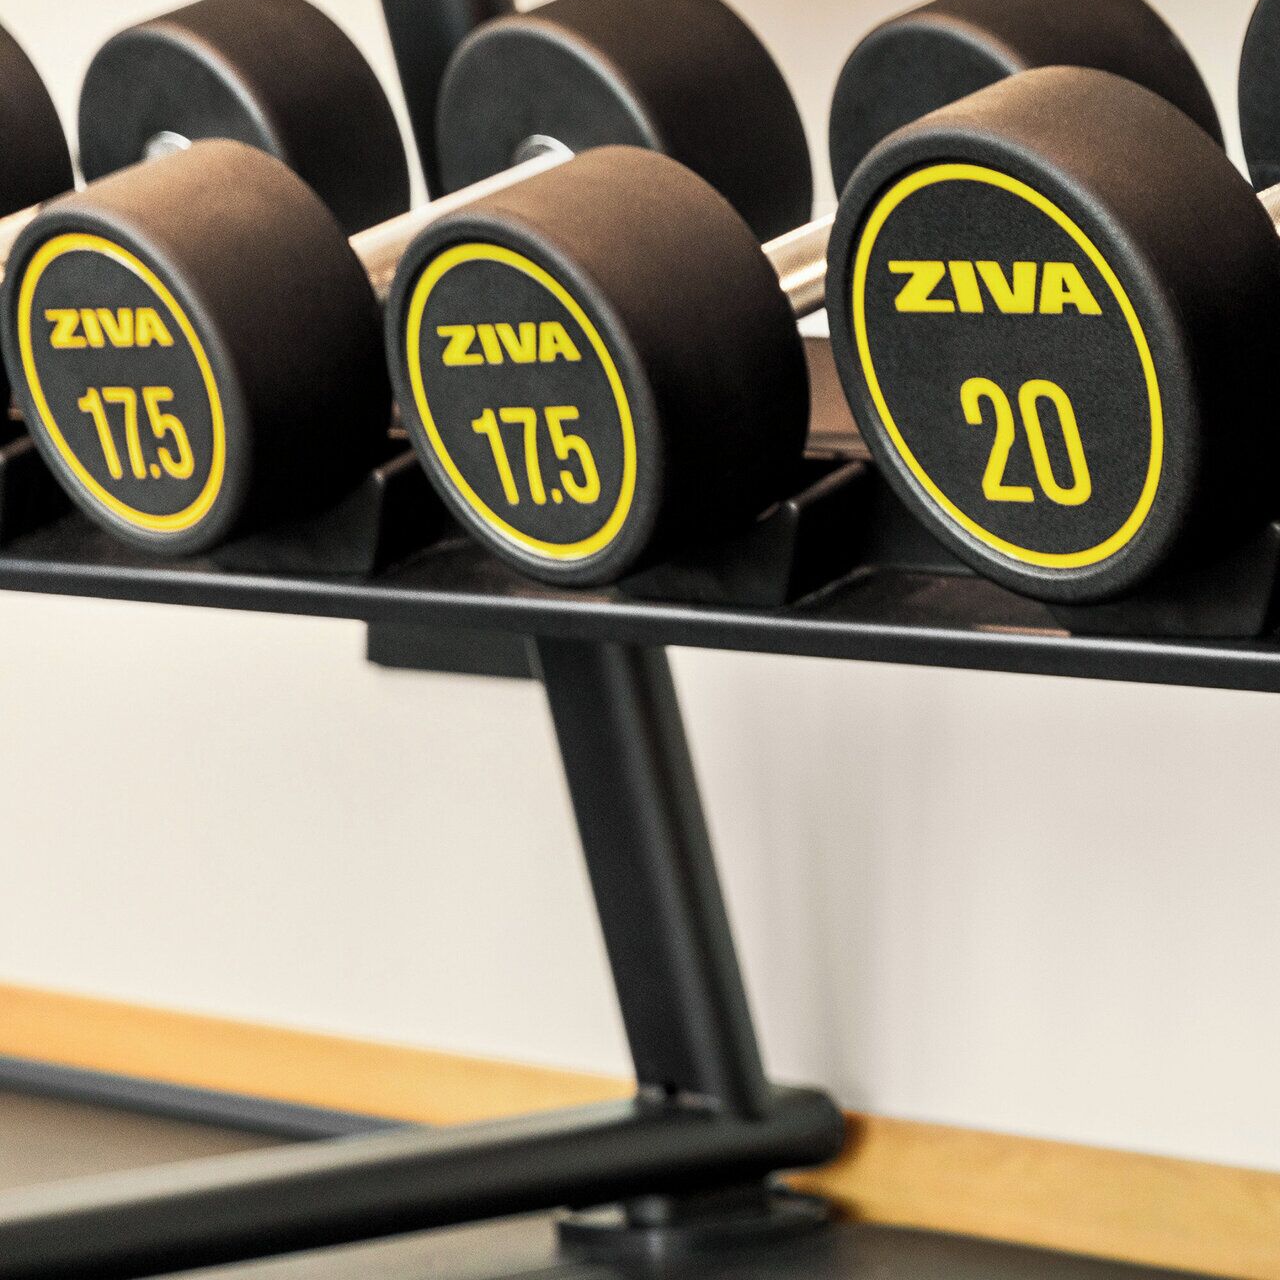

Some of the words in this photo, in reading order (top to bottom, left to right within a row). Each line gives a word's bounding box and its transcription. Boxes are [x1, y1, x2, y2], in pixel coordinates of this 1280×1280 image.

[887, 259, 1103, 316] ZIVA
[44, 307, 174, 348] ZIVA
[436, 321, 582, 366] ZIVA
[78, 386, 194, 480] 17.5
[470, 405, 602, 505] 17.5
[959, 376, 1093, 507] 20
